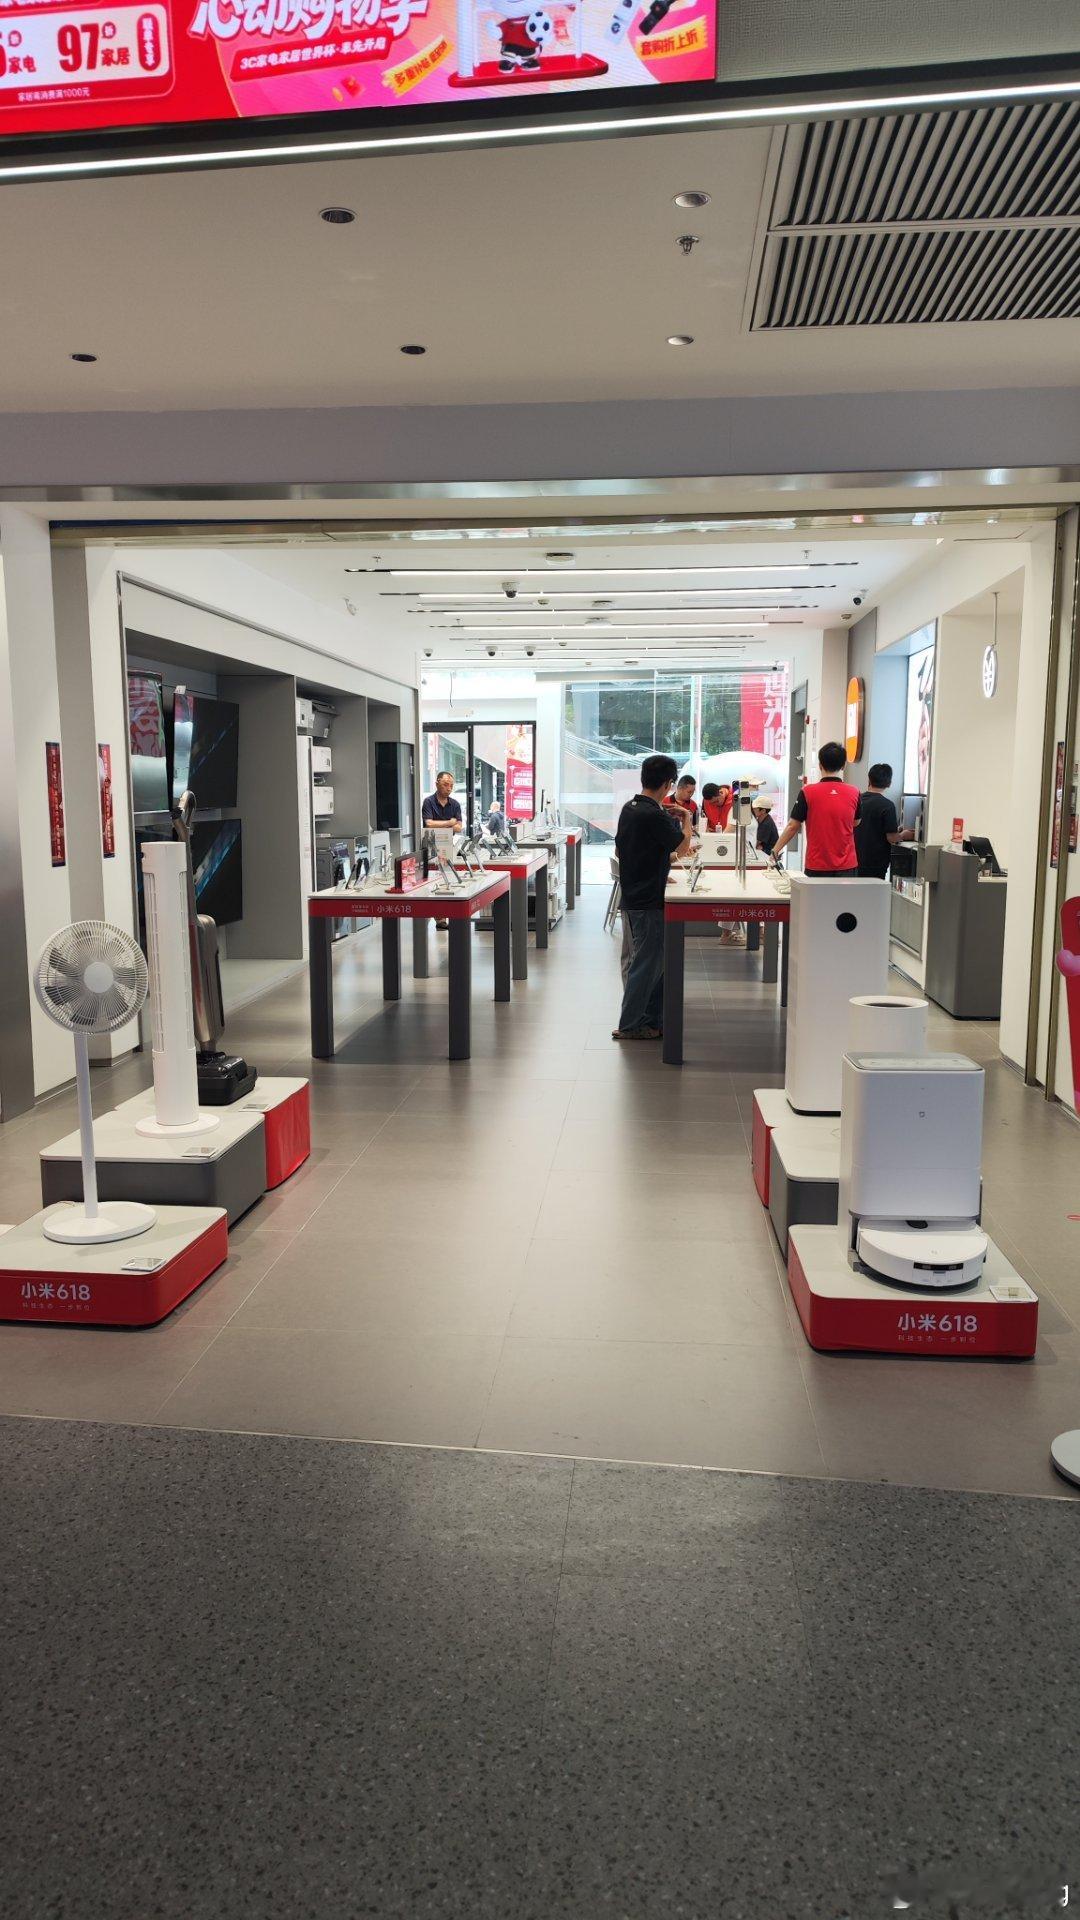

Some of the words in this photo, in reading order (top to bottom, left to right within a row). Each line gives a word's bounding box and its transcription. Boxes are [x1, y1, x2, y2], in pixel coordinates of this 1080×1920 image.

[57, 23, 100, 72] 97
[101, 47, 130, 66] 家居
[8, 55, 37, 74] 家电
[376, 904, 412, 915] 小米618
[738, 908, 776, 918] 小米618
[21, 1281, 91, 1301] 小米618
[897, 1312, 978, 1333] 小米618
